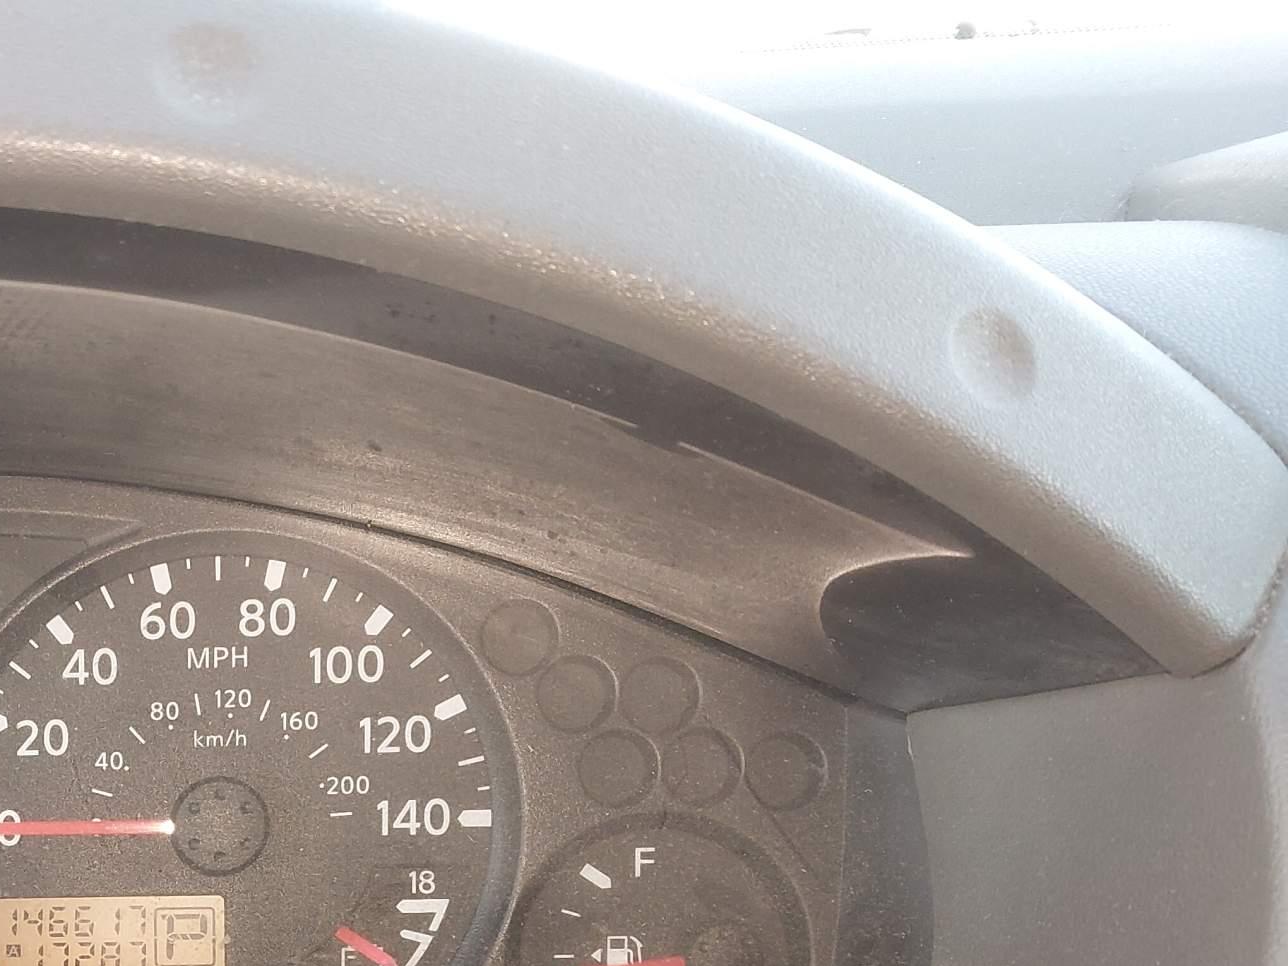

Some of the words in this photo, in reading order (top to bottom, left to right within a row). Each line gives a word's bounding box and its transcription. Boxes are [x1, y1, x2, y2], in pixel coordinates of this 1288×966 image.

[140, 601, 196, 641] 60
[238, 597, 296, 637] 80
[60, 648, 119, 686] 40
[187, 645, 248, 669] MPH
[309, 644, 384, 684] 100
[150, 701, 179, 721] 80
[214, 688, 252, 709] 120
[280, 711, 318, 731] 160
[359, 715, 432, 754] 120
[16, 718, 69, 757] 20
[193, 728, 247, 748] km/h
[94, 751, 124, 771] 40
[326, 775, 370, 795] 200
[376, 797, 450, 836] 140
[634, 847, 656, 878] F
[408, 870, 436, 895] 18
[11, 906, 146, 938] 146617
[161, 913, 208, 961] P
